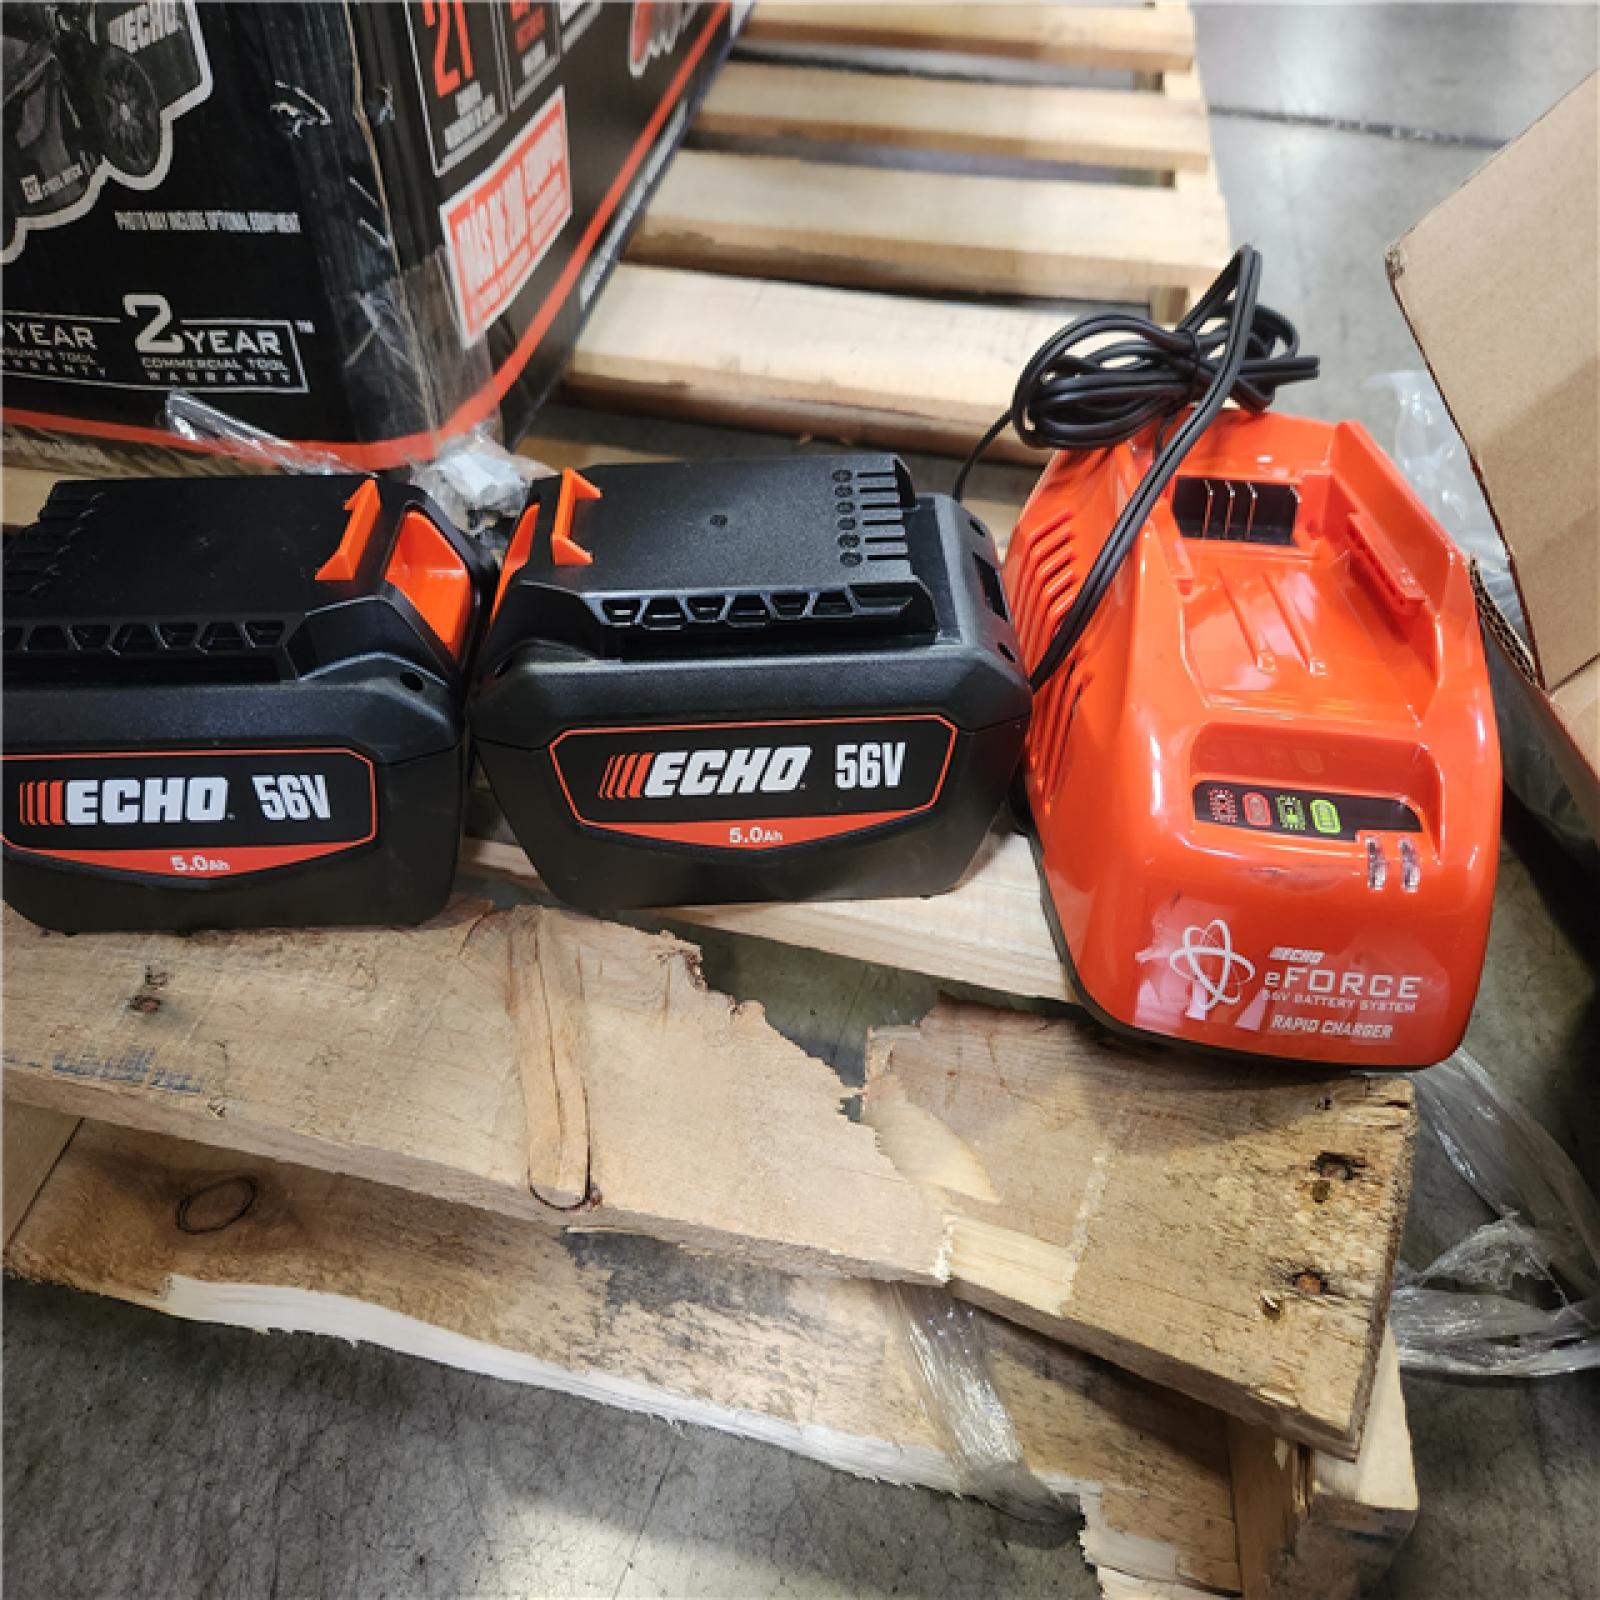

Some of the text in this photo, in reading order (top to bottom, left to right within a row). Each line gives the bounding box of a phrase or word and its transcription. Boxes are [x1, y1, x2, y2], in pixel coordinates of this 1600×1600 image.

[6, 322, 98, 350] YEAR
[122, 293, 283, 355] 2 YEAR
[141, 357, 289, 371] COMMERCIAL TOOL
[146, 371, 291, 384] WARRANTY
[644, 742, 906, 798] ECHO 56V
[65, 774, 331, 825] ECHO 56V
[729, 827, 783, 844] 5.0Ah
[170, 855, 231, 871] 5.0Ah
[1264, 966, 1423, 999] eFORCE
[1294, 994, 1356, 1009] BATTERY
[1359, 1000, 1416, 1014] SYSTEM
[1271, 1014, 1393, 1039] RAPID CHARGER
